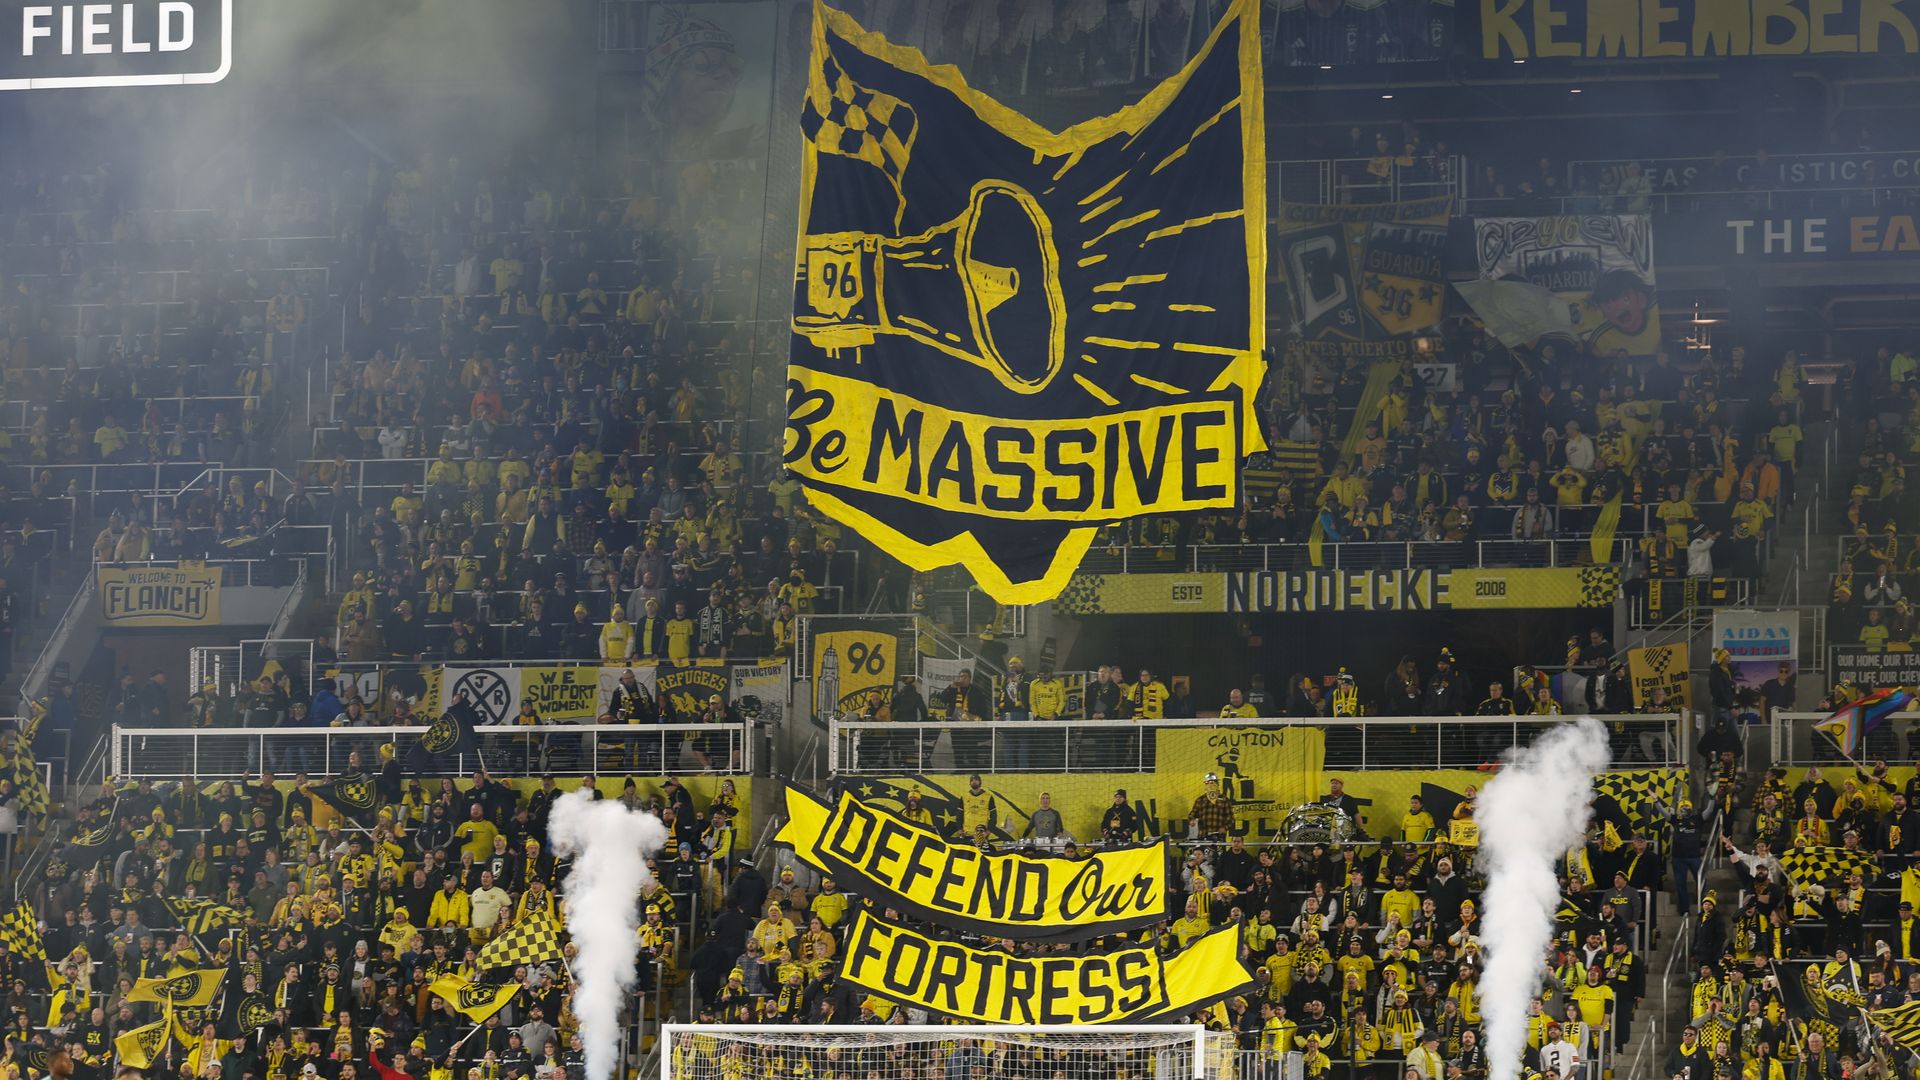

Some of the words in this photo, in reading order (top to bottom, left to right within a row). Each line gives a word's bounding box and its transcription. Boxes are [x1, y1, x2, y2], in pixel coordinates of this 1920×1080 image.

[23, 2, 194, 56] FIELD
[1726, 217, 1828, 255] THE
[823, 261, 858, 299] 96
[1378, 285, 1414, 320] 96
[1338, 308, 1356, 326] 96
[1341, 340, 1407, 357] MUERTO
[1422, 367, 1448, 387] 27
[783, 378, 849, 474] Be
[863, 397, 1226, 512] MASSIVE
[128, 572, 172, 584] WELCOME
[175, 573, 186, 584] TO
[1227, 568, 1451, 612] NORDECKE
[1475, 580, 1507, 597] 2008
[1723, 627, 1789, 639] AIDAN
[847, 642, 885, 676] 96
[1838, 654, 1854, 666] OUR
[1856, 654, 1883, 669] HOME,
[1883, 655, 1900, 666] OUR
[540, 671, 575, 684] WE
[656, 669, 728, 692] REFUGEES
[734, 668, 750, 678] OUR
[751, 665, 782, 677] VICTORY
[1840, 672, 1857, 683] OUR
[1879, 671, 1898, 683] OUR
[1641, 675, 1664, 687] can't
[528, 684, 597, 702] SUPPORT
[538, 700, 589, 713] WOMEN.
[1208, 732, 1284, 748] CAUTION
[830, 803, 1049, 922] DEFEND
[1061, 857, 1157, 922] Our
[849, 917, 1151, 1026] FORTRESS
[1550, 1050, 1560, 1066] 2
